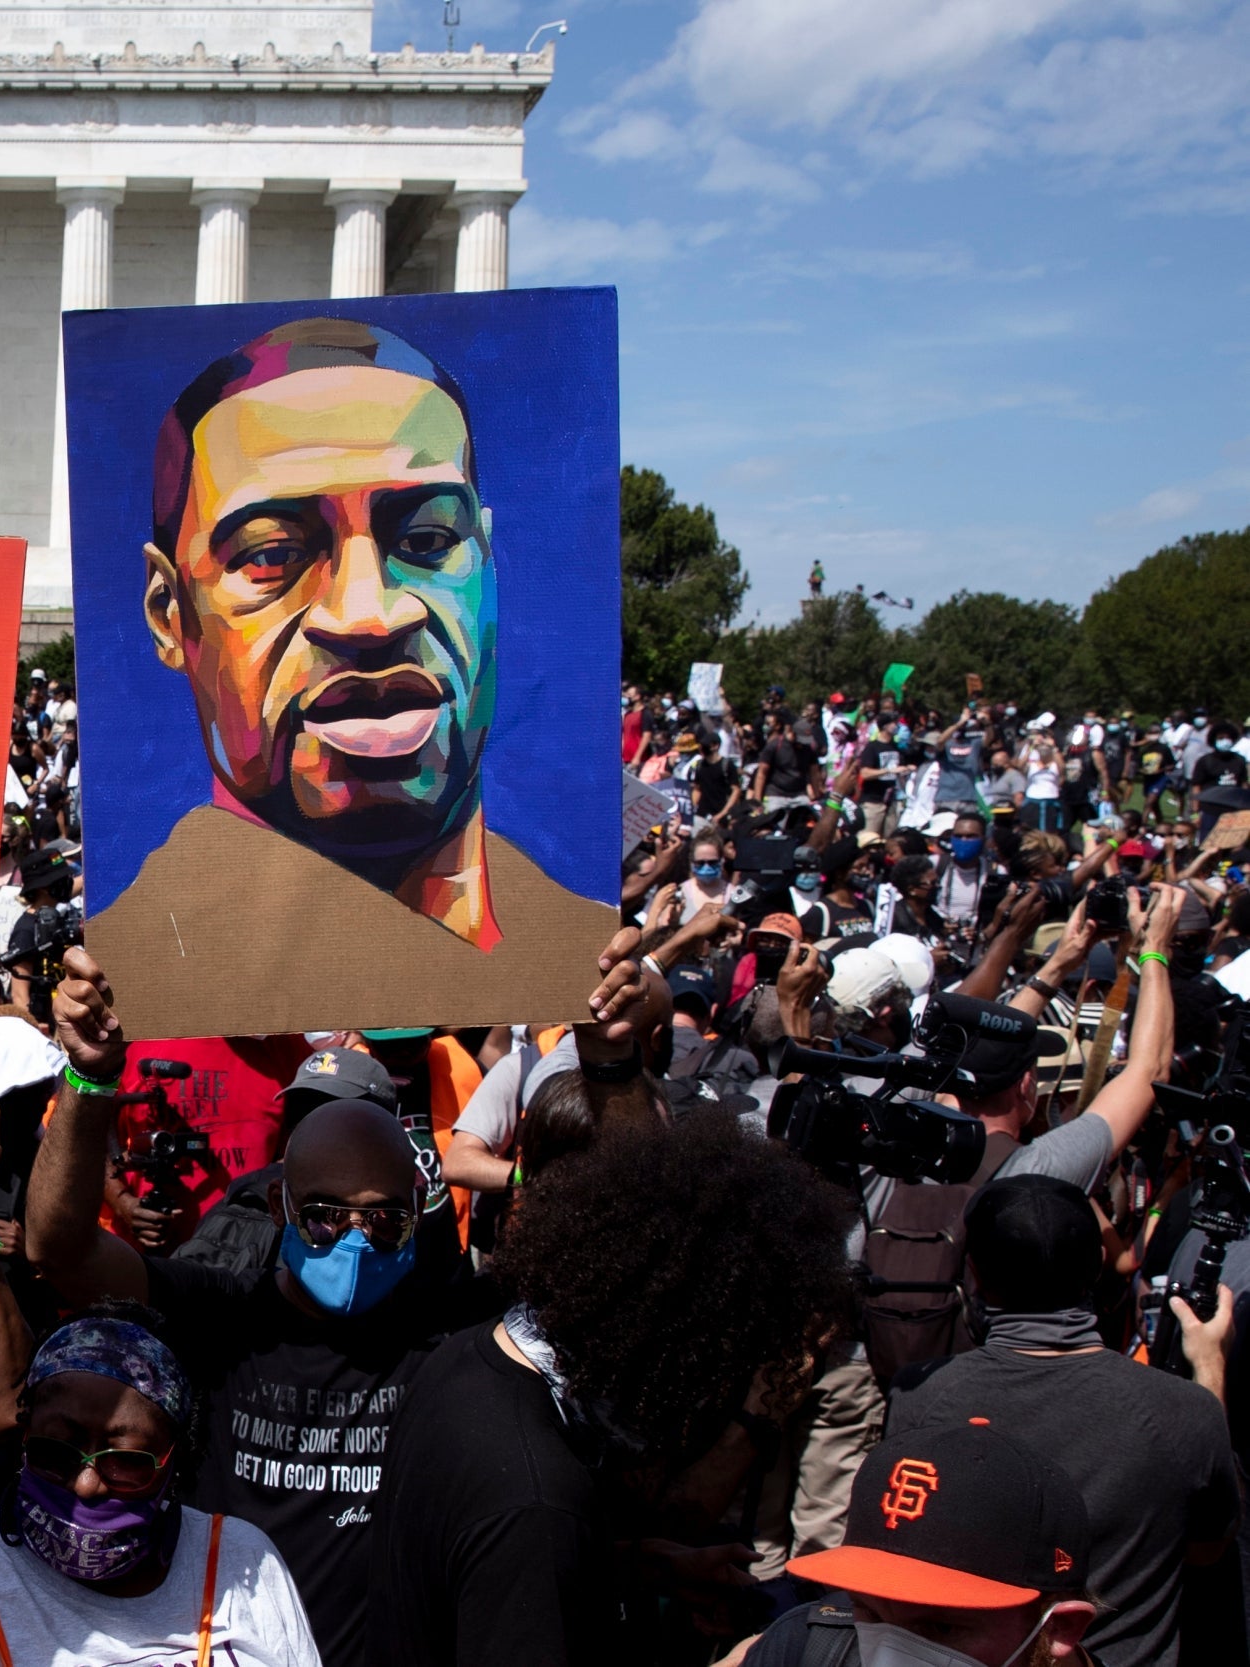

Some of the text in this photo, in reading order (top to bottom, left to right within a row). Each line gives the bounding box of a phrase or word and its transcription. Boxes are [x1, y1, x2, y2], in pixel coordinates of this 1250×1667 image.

[979, 1011, 1022, 1033] RØDE
[231, 1408, 250, 1440] TO
[250, 1416, 296, 1452] MAKE
[298, 1427, 340, 1454] SOME
[235, 1450, 262, 1483] GET
[263, 1459, 282, 1488] IN
[284, 1464, 327, 1492] GOOD
